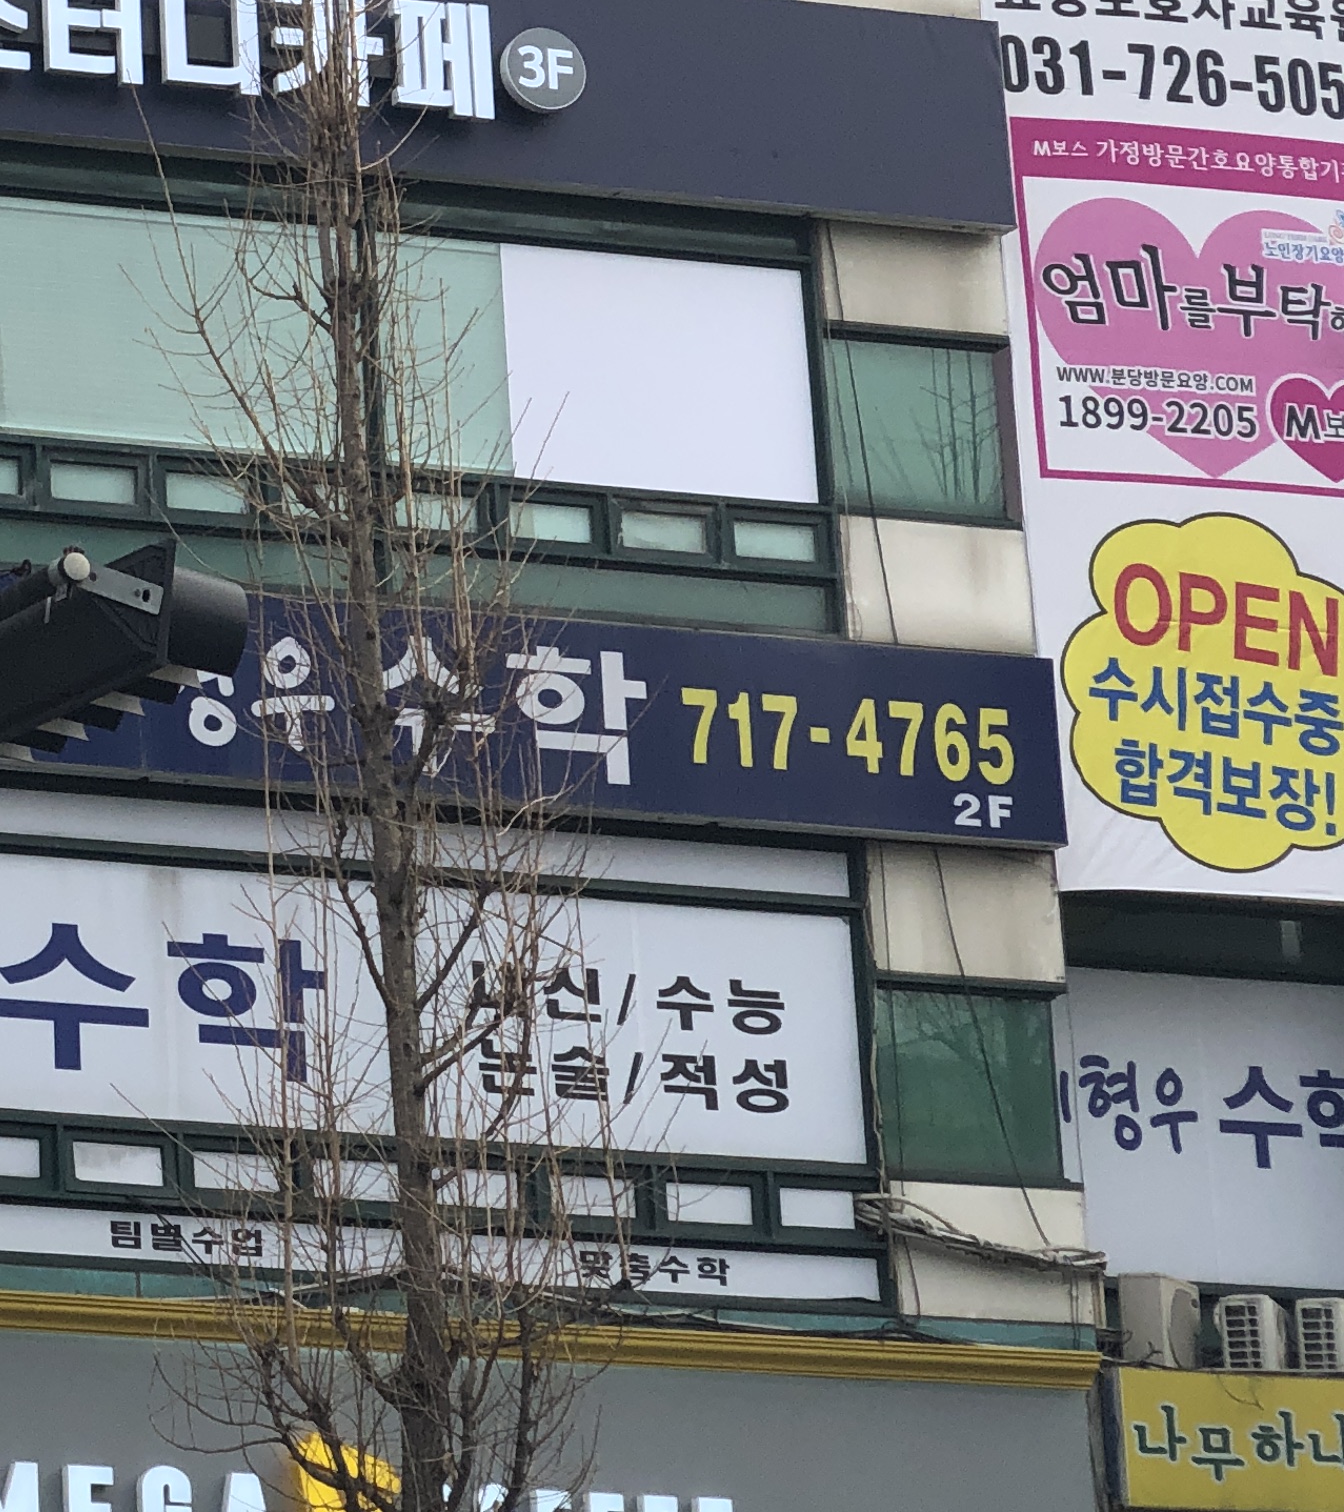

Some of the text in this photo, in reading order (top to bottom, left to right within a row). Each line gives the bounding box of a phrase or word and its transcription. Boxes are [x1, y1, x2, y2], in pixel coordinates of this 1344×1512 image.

[517, 44, 574, 93] 3F
[1033, 139, 1344, 184] M보스 가정방문간호요양통합기
[1058, 394, 1258, 439] 1899-2205
[1113, 562, 1340, 678] OPEN
[380, 636, 648, 787] 수학
[680, 687, 1017, 786] 717-4765
[1088, 656, 1344, 757] 수시접수중
[952, 792, 1014, 829] 2F
[1113, 738, 1338, 837] 합격보장!
[470, 959, 786, 1037] 내신/수능
[109, 1219, 263, 1258] 팀별수업
